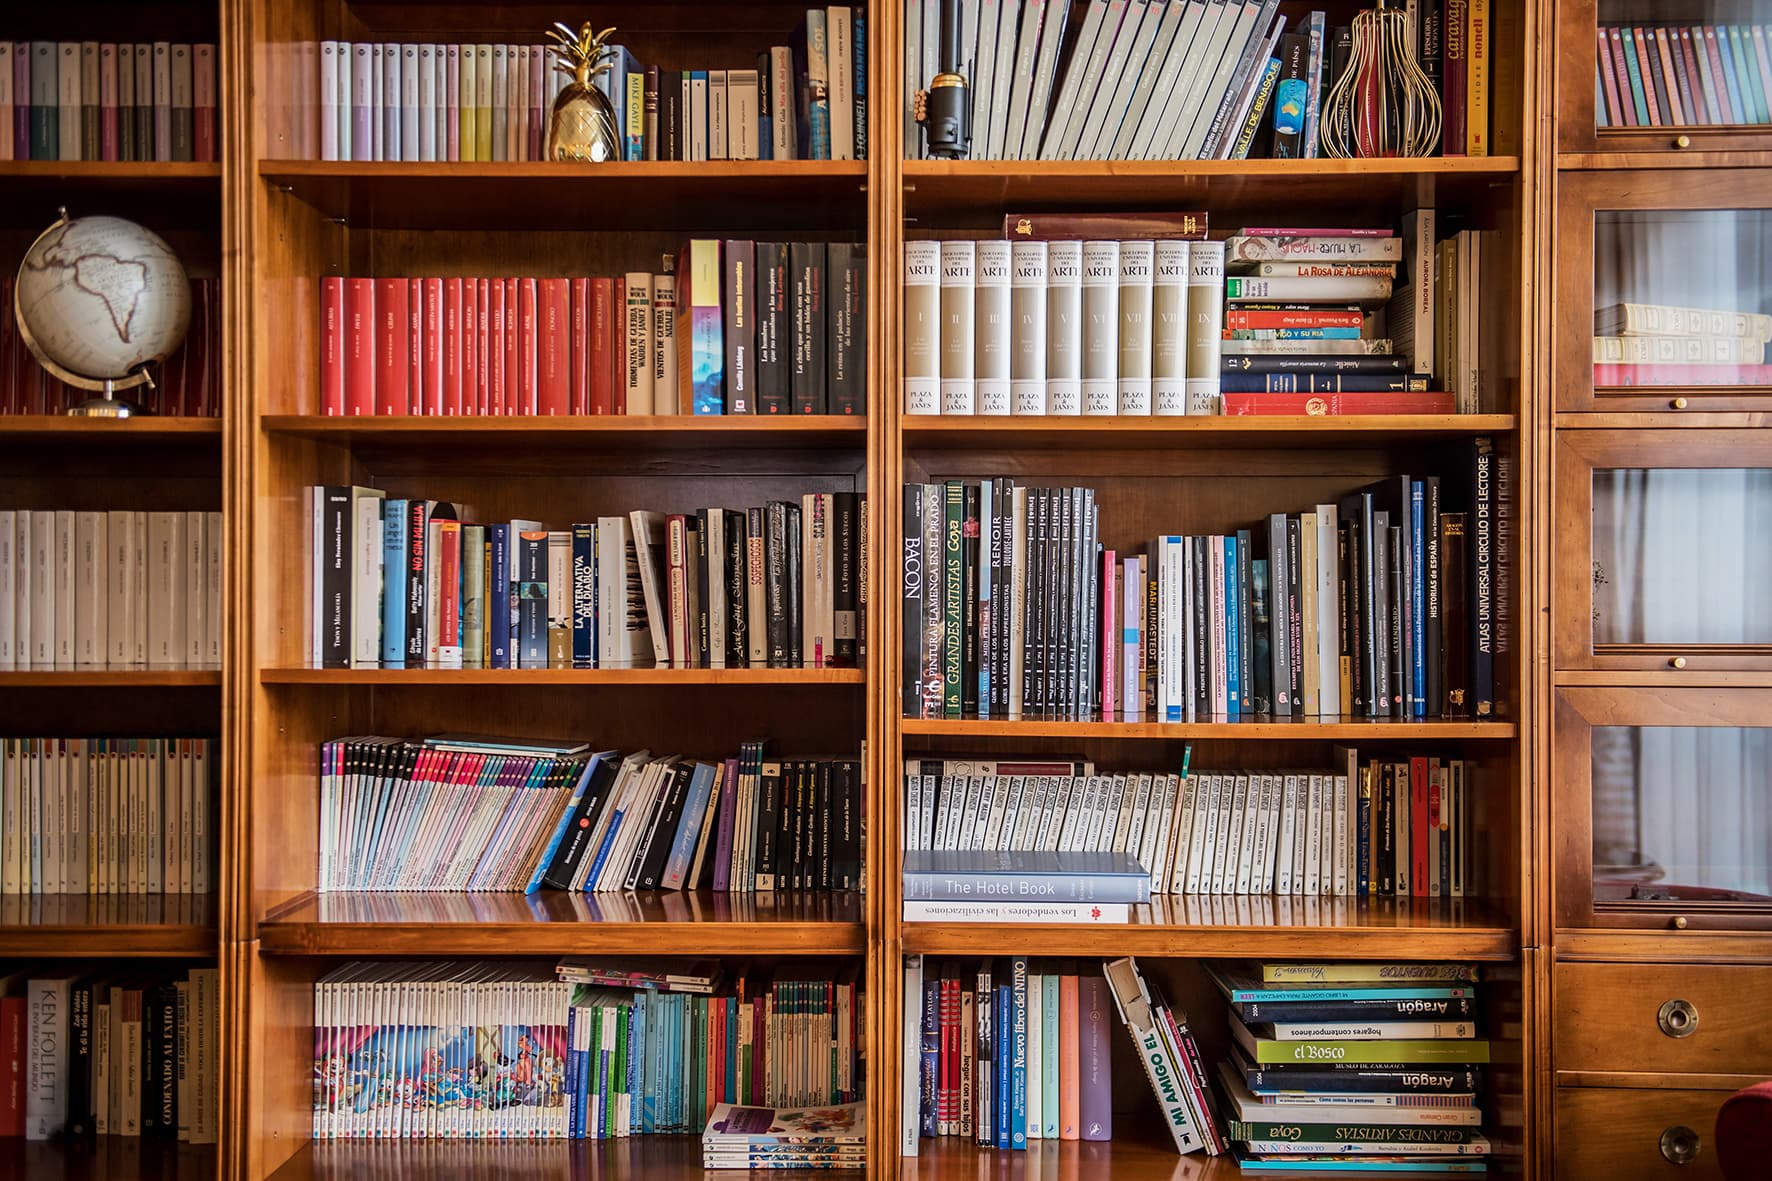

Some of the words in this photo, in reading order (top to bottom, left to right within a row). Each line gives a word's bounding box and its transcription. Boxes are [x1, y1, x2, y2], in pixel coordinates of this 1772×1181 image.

[1473, 19, 1482, 58] nonell
[632, 77, 640, 99] MIKE
[1236, 127, 1253, 155] VALLE
[1249, 115, 1259, 126] DE
[1255, 61, 1279, 111] BENASQUE
[632, 102, 640, 130] GAYLE
[907, 266, 937, 275] ARTE
[944, 267, 971, 277] ARTE
[1120, 266, 1150, 276] ARTE
[1298, 266, 1309, 277] LA
[1311, 266, 1332, 277] ROSA
[1334, 266, 1344, 277] DE
[630, 308, 638, 336] GUERRA
[638, 308, 646, 330] JANICE
[630, 338, 638, 346] DE
[656, 340, 664, 348] DE
[770, 340, 776, 349] no
[638, 340, 646, 368] WARREN
[630, 348, 638, 388] TORMENTAS
[1228, 359, 1237, 368] 12
[837, 372, 844, 380] La
[1479, 452, 1490, 501] LECTORE
[928, 495, 938, 531] PRADO
[1479, 503, 1490, 518] DE
[928, 535, 938, 547] EL
[948, 520, 961, 552] Goya
[992, 516, 1000, 567] RENOIR
[1004, 516, 1012, 566] TOULOUSE-LAUTREC
[1479, 520, 1490, 562] CIRCULO
[750, 538, 762, 585] SOSPECHOSOS
[842, 552, 848, 561] DE
[928, 550, 938, 565] EN
[905, 537, 920, 599] BACON
[576, 556, 584, 614] ALTERNATIVA
[948, 560, 960, 619] ARTISTAS
[1479, 564, 1490, 620] UNIVERSAL
[928, 568, 938, 627] FLAMENCA
[576, 618, 584, 629] LA
[1479, 623, 1490, 653] ATLAS
[928, 630, 938, 677] PINTURA
[948, 622, 960, 684] GRANDES
[991, 651, 998, 659] DE
[1002, 652, 1009, 660] DE
[1002, 676, 1009, 684] LA
[945, 880, 971, 894] The
[976, 880, 1014, 894] Hotel
[1020, 880, 1055, 894] Book
[925, 908, 984, 917] civilizaciones
[985, 908, 999, 917] las
[1008, 908, 1059, 917] vendedores
[1061, 908, 1076, 917] Los
[40, 990, 56, 1025] KEN
[1014, 993, 1025, 1008] del
[1397, 1000, 1448, 1014] Aragón
[1014, 1010, 1025, 1033] libro
[1291, 1028, 1352, 1037] contemporáneos
[1353, 1028, 1382, 1037] hogares
[164, 1043, 172, 1056] AL
[1144, 1034, 1156, 1050] EL
[1014, 1035, 1025, 1068] Nuevo
[1294, 1046, 1304, 1059] el
[1307, 1046, 1344, 1059] Bosco
[40, 1032, 56, 1103] FOLLETT
[962, 1055, 971, 1079] Juegue
[1151, 1054, 1178, 1102] AMIGO
[1403, 1075, 1454, 1089] Aragón
[164, 1060, 172, 1124] CONDENADO
[962, 1083, 971, 1096] con
[962, 1099, 971, 1111] sus
[962, 1114, 971, 1132] hijos
[1174, 1107, 1187, 1126] MI
[1270, 1127, 1302, 1140] Goya
[1336, 1127, 1396, 1140] ARTISTAS
[1399, 1127, 1463, 1140] GRANDES
